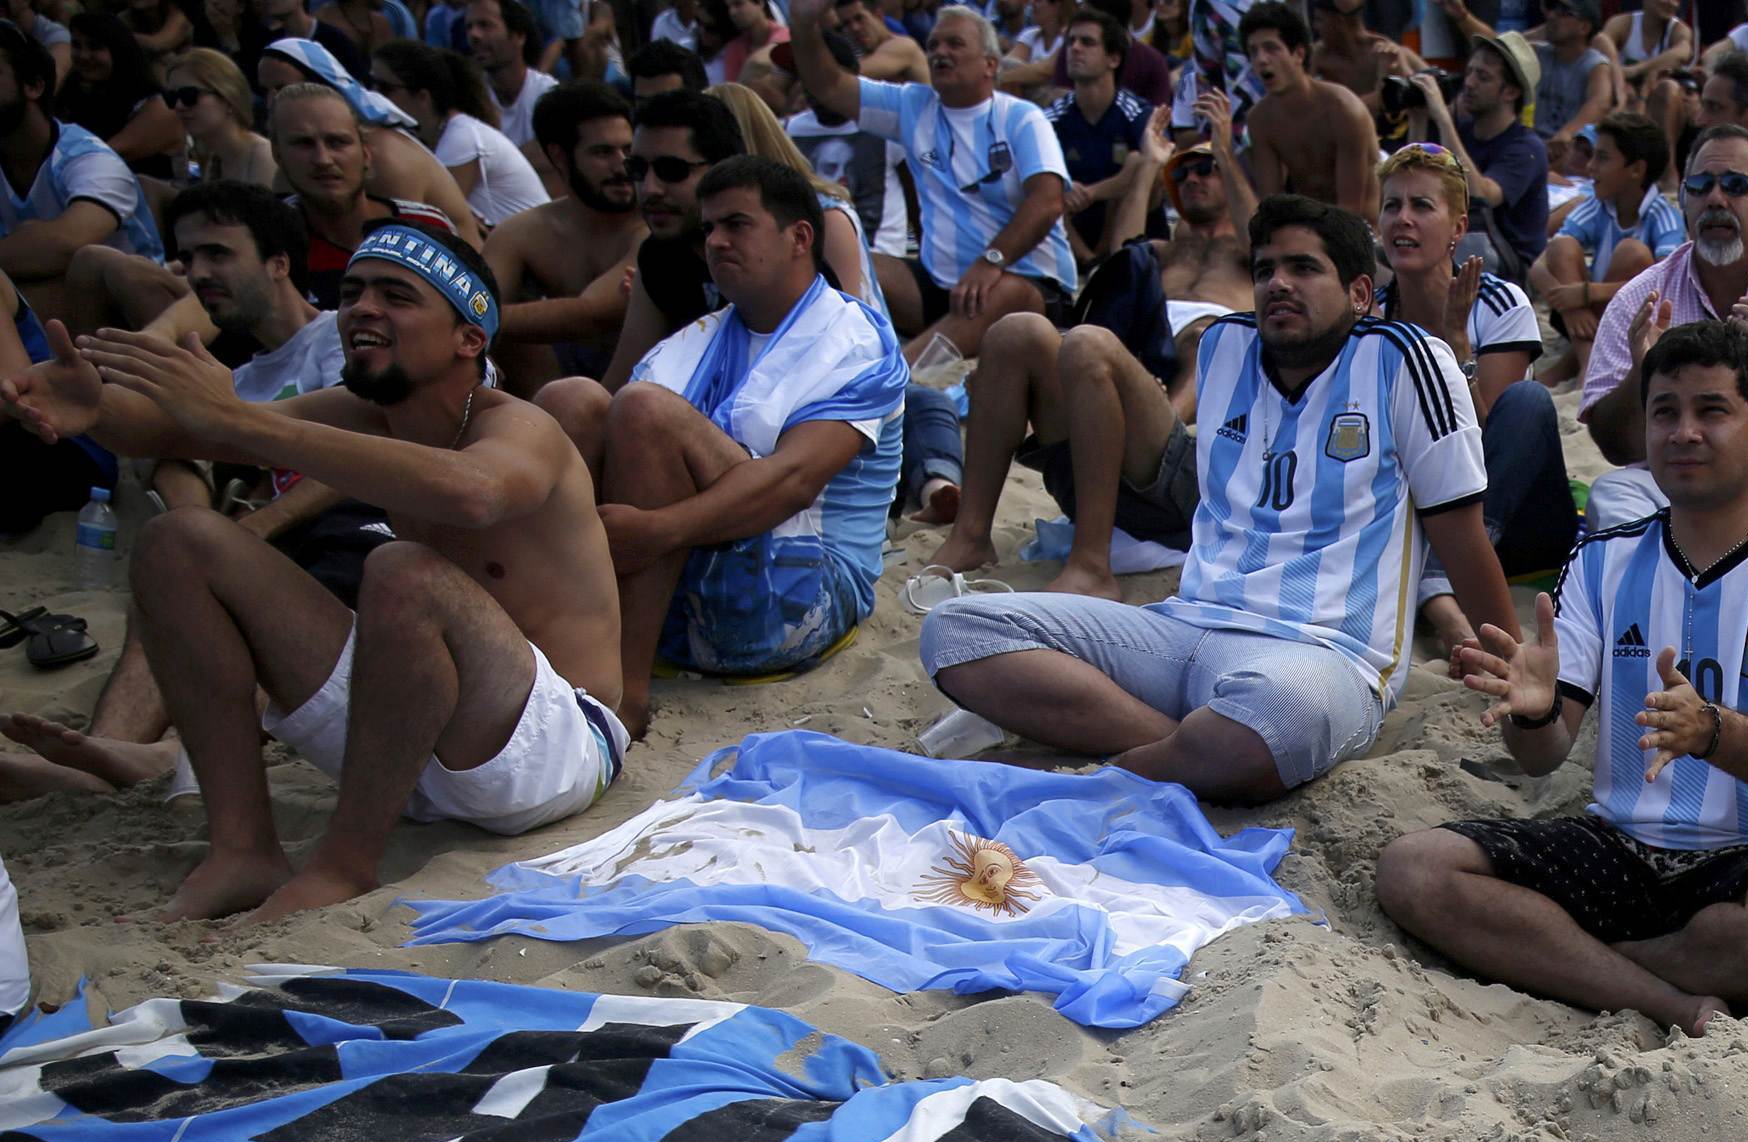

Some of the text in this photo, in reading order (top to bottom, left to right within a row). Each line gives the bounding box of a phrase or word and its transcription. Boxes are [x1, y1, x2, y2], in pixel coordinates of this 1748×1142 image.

[1216, 427, 1247, 446] adidas
[1255, 450, 1298, 512] 10
[1612, 646, 1651, 658] adidas
